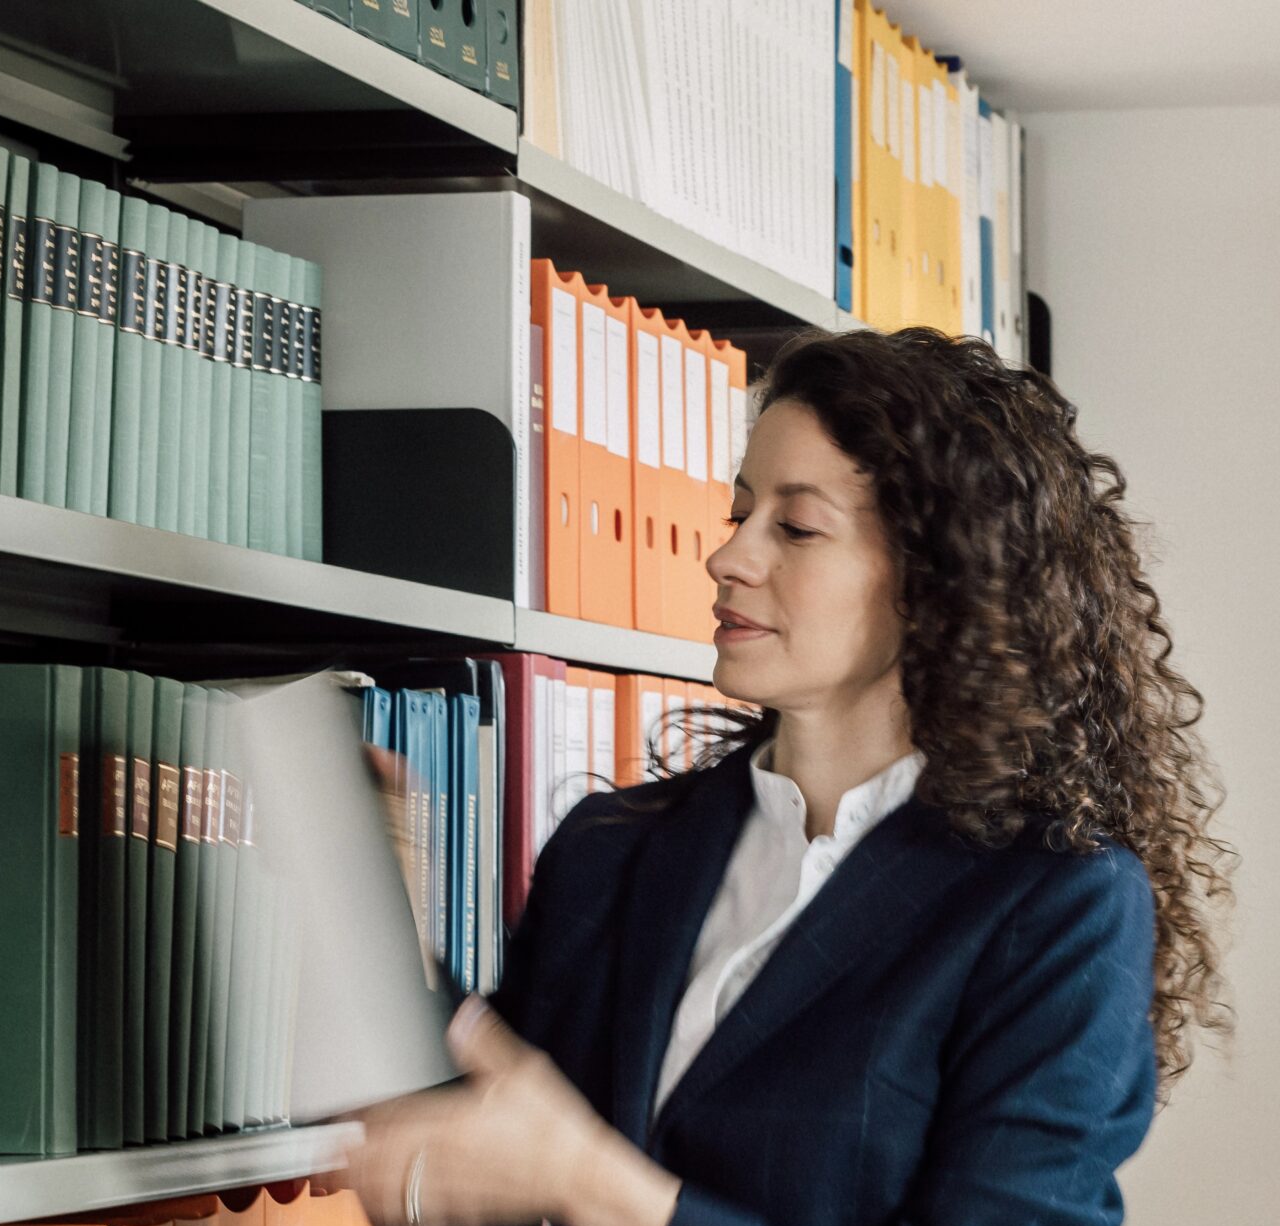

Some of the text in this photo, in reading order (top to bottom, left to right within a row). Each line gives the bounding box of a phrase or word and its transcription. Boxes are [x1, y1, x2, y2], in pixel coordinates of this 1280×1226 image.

[421, 792, 430, 908] International
[439, 793, 448, 942] International Tax
[466, 794, 477, 908] International
[466, 911, 476, 943] Tax
